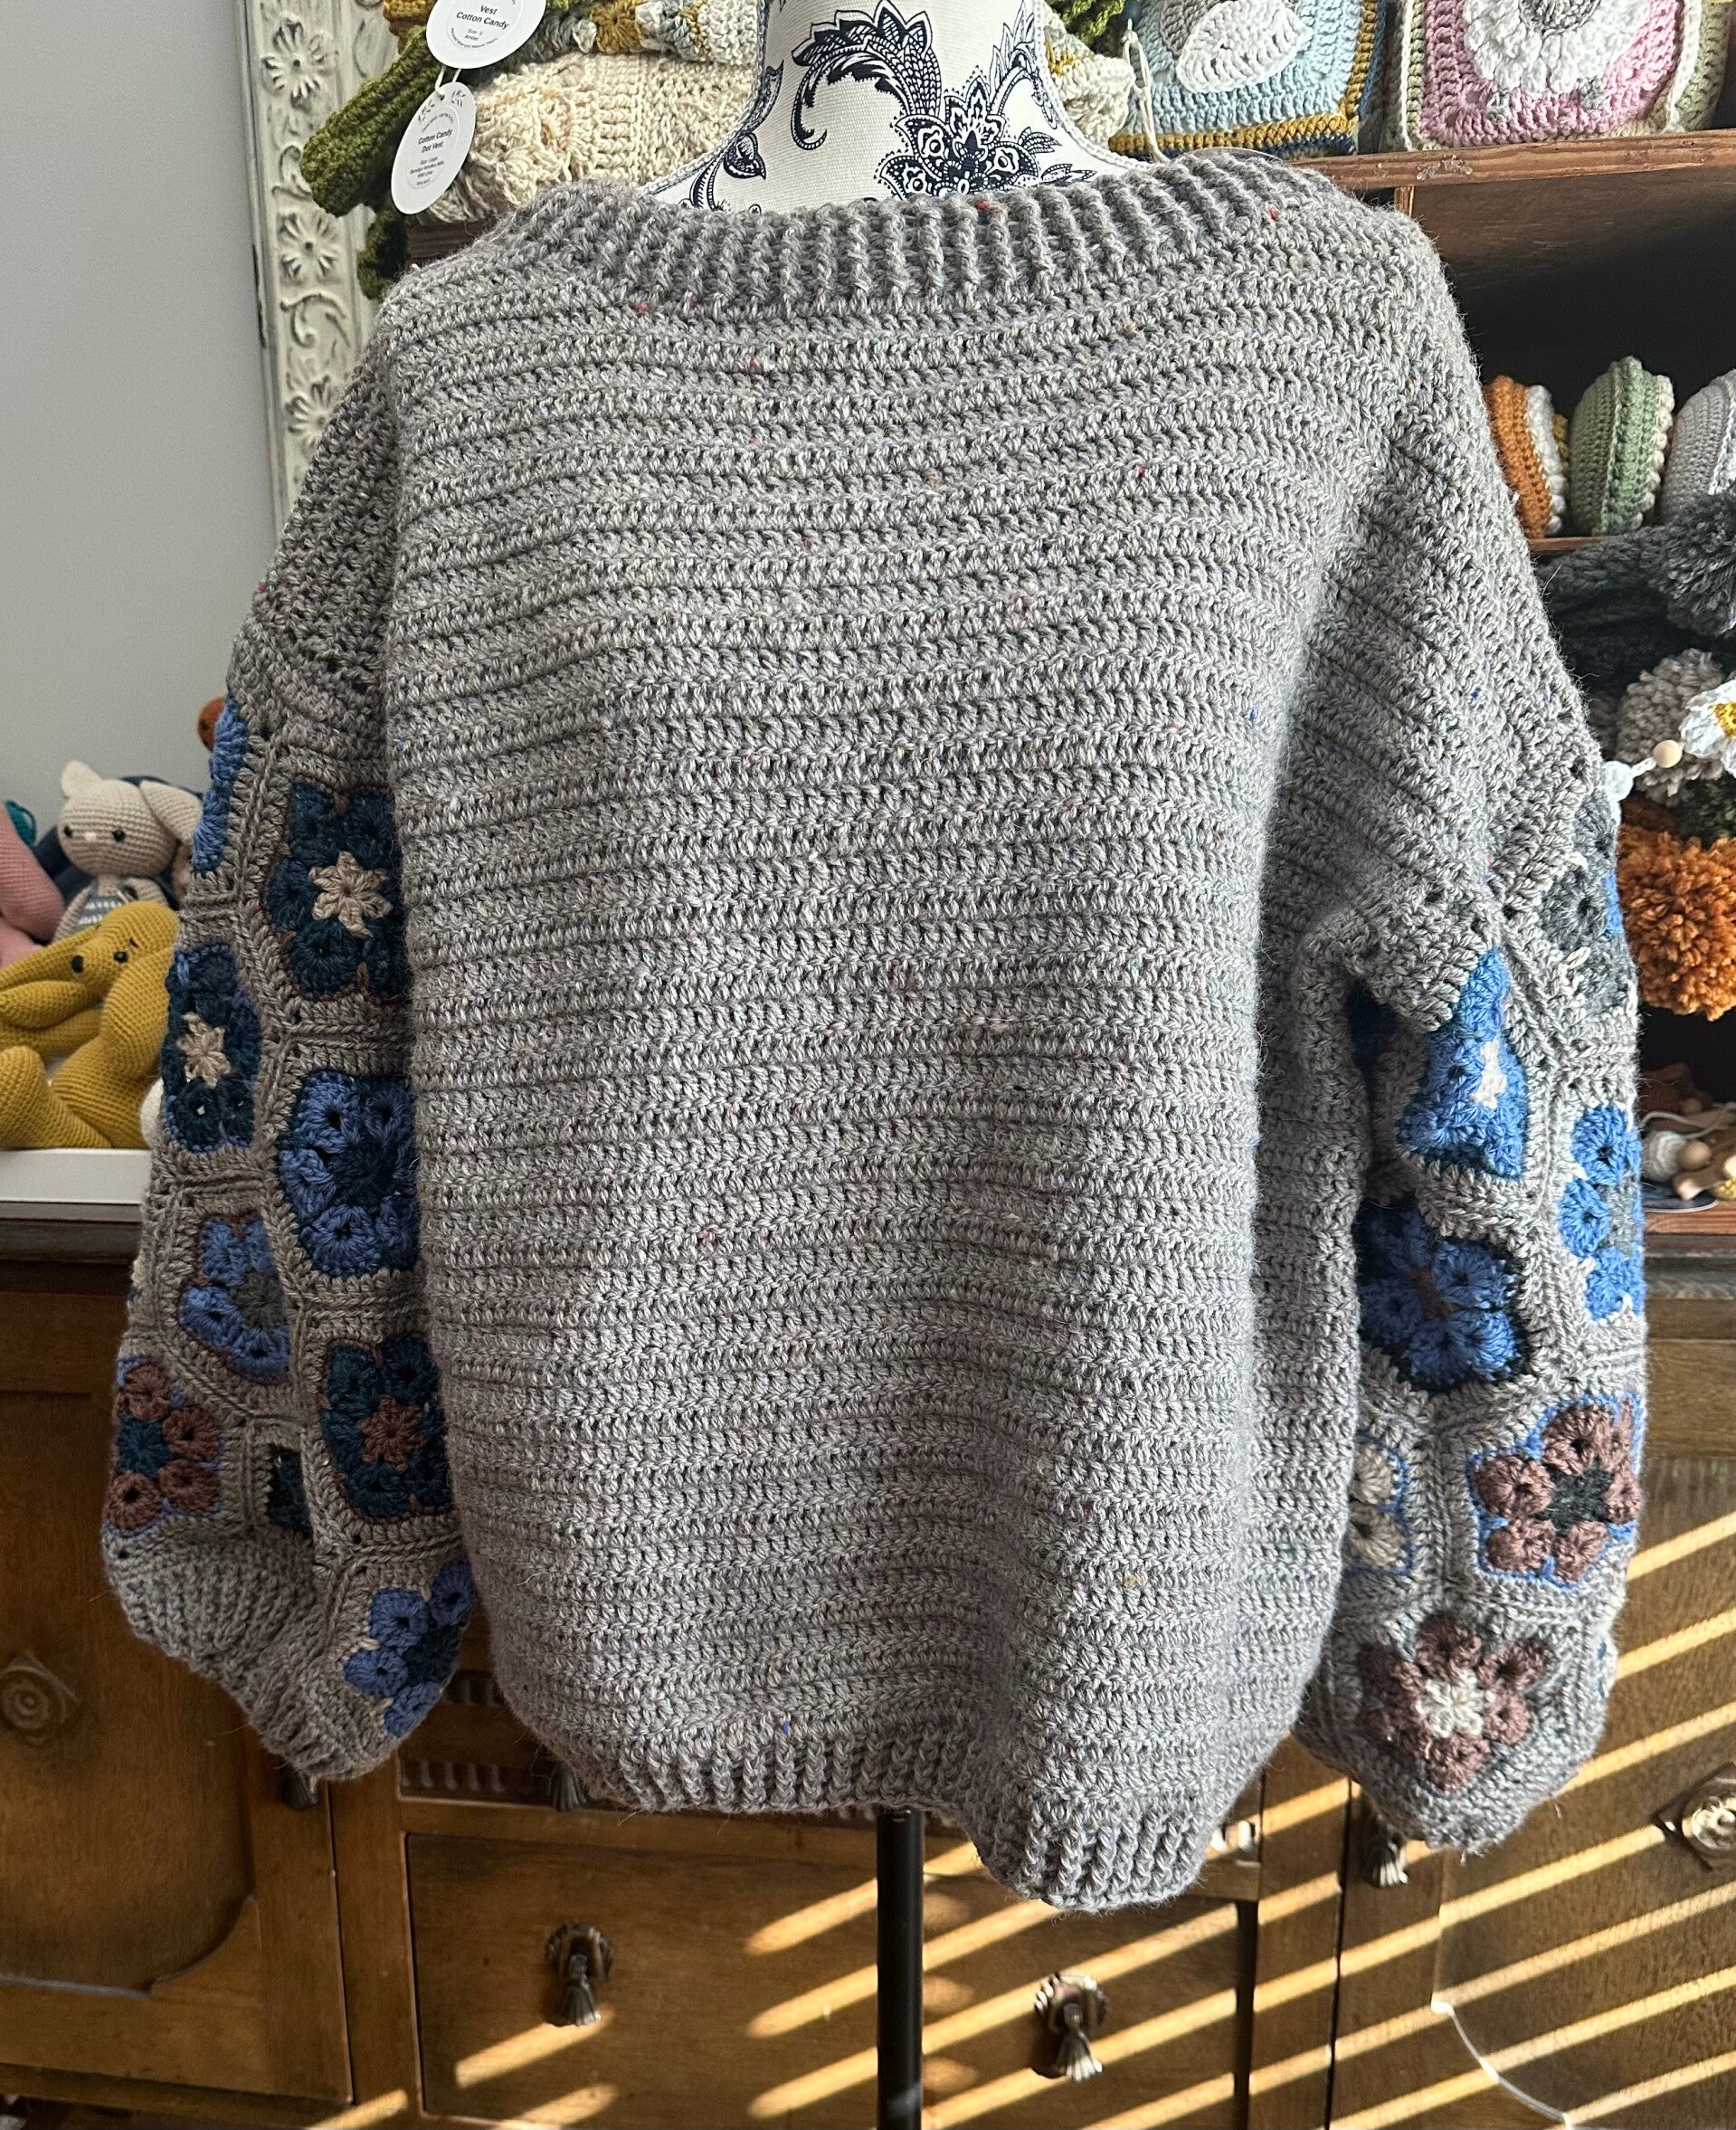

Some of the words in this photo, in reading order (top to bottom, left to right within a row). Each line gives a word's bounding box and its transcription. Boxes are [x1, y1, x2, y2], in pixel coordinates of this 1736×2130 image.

[480, 5, 498, 14] Vest
[456, 12, 482, 23] Cotton
[483, 17, 509, 30] Candy
[418, 135, 435, 145] Cotton
[436, 128, 453, 139] Candy
